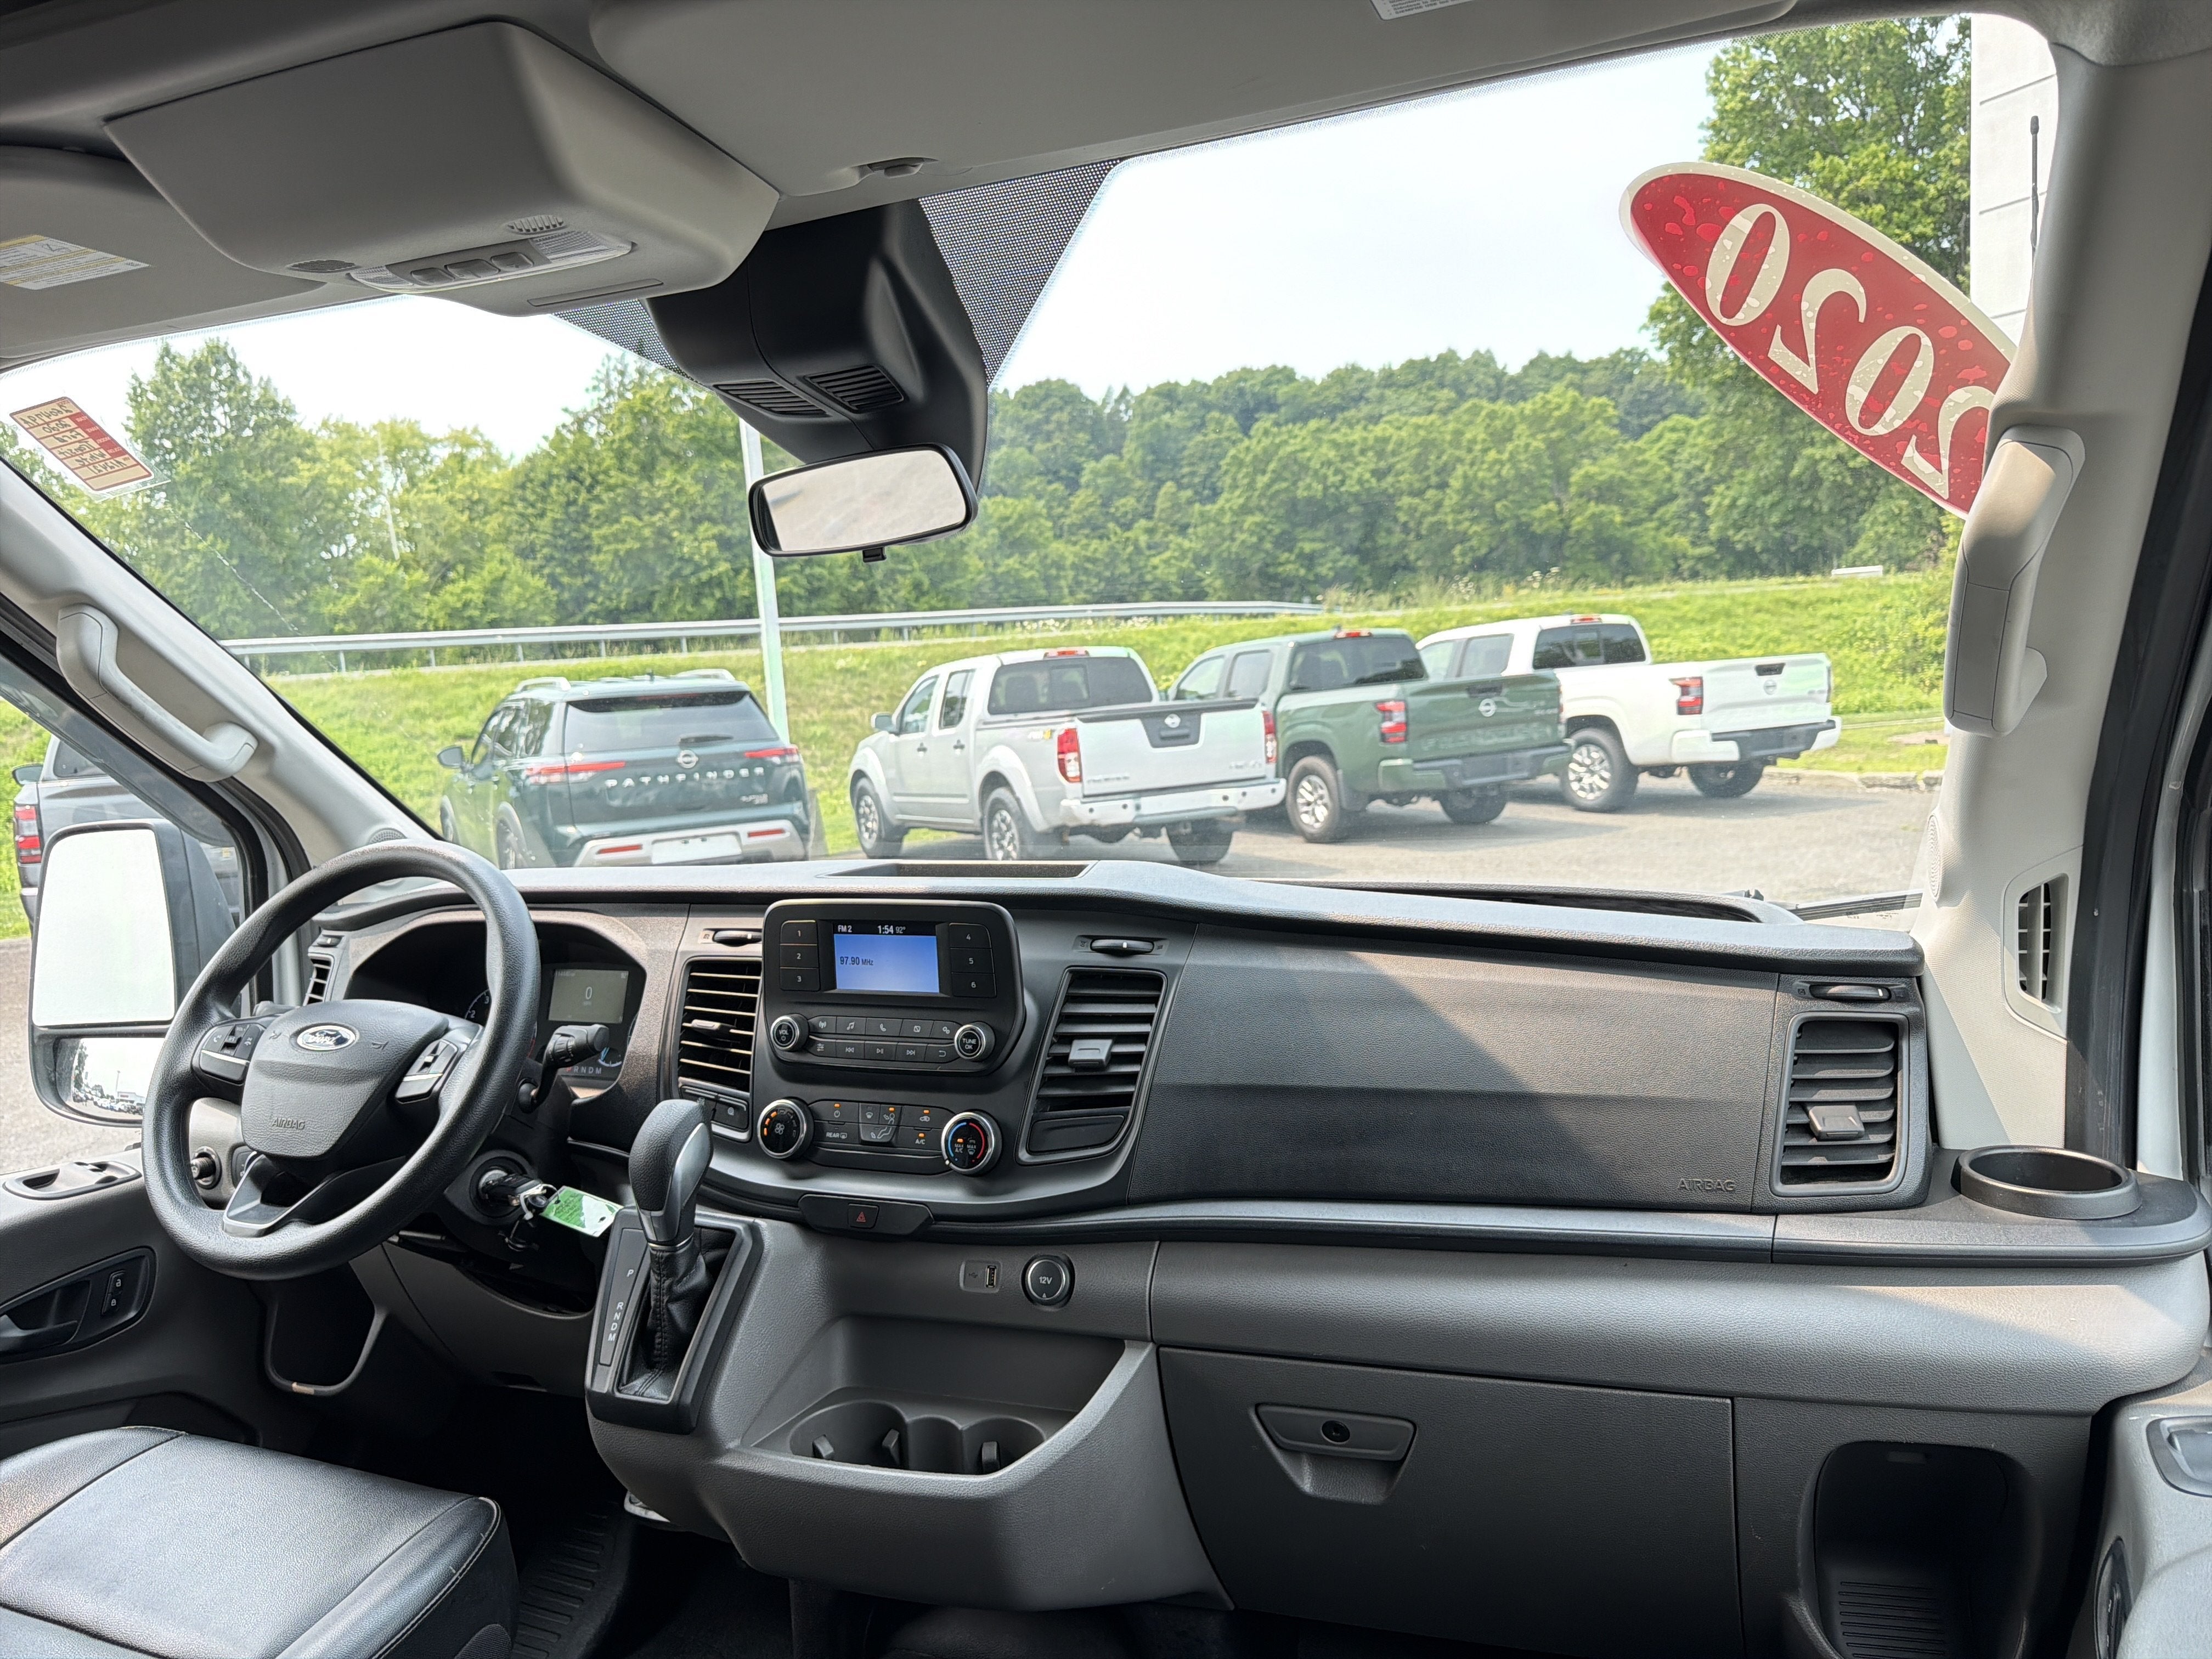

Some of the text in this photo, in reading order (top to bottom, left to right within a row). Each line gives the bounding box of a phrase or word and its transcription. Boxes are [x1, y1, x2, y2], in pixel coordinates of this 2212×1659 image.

[605, 767, 764, 788] PATHFINDER
[878, 925, 894, 934] 1:54
[840, 956, 860, 966] 97.90
[470, 1010, 476, 1019] 2
[272, 1117, 306, 1130] AIRBAG
[1678, 1178, 1736, 1192] AIRBAG
[627, 1269, 634, 1277] P
[1039, 1276, 1052, 1284] 12V
[617, 1302, 624, 1310] R
[613, 1312, 621, 1321] N
[611, 1322, 618, 1331] D
[608, 1333, 616, 1341] M
